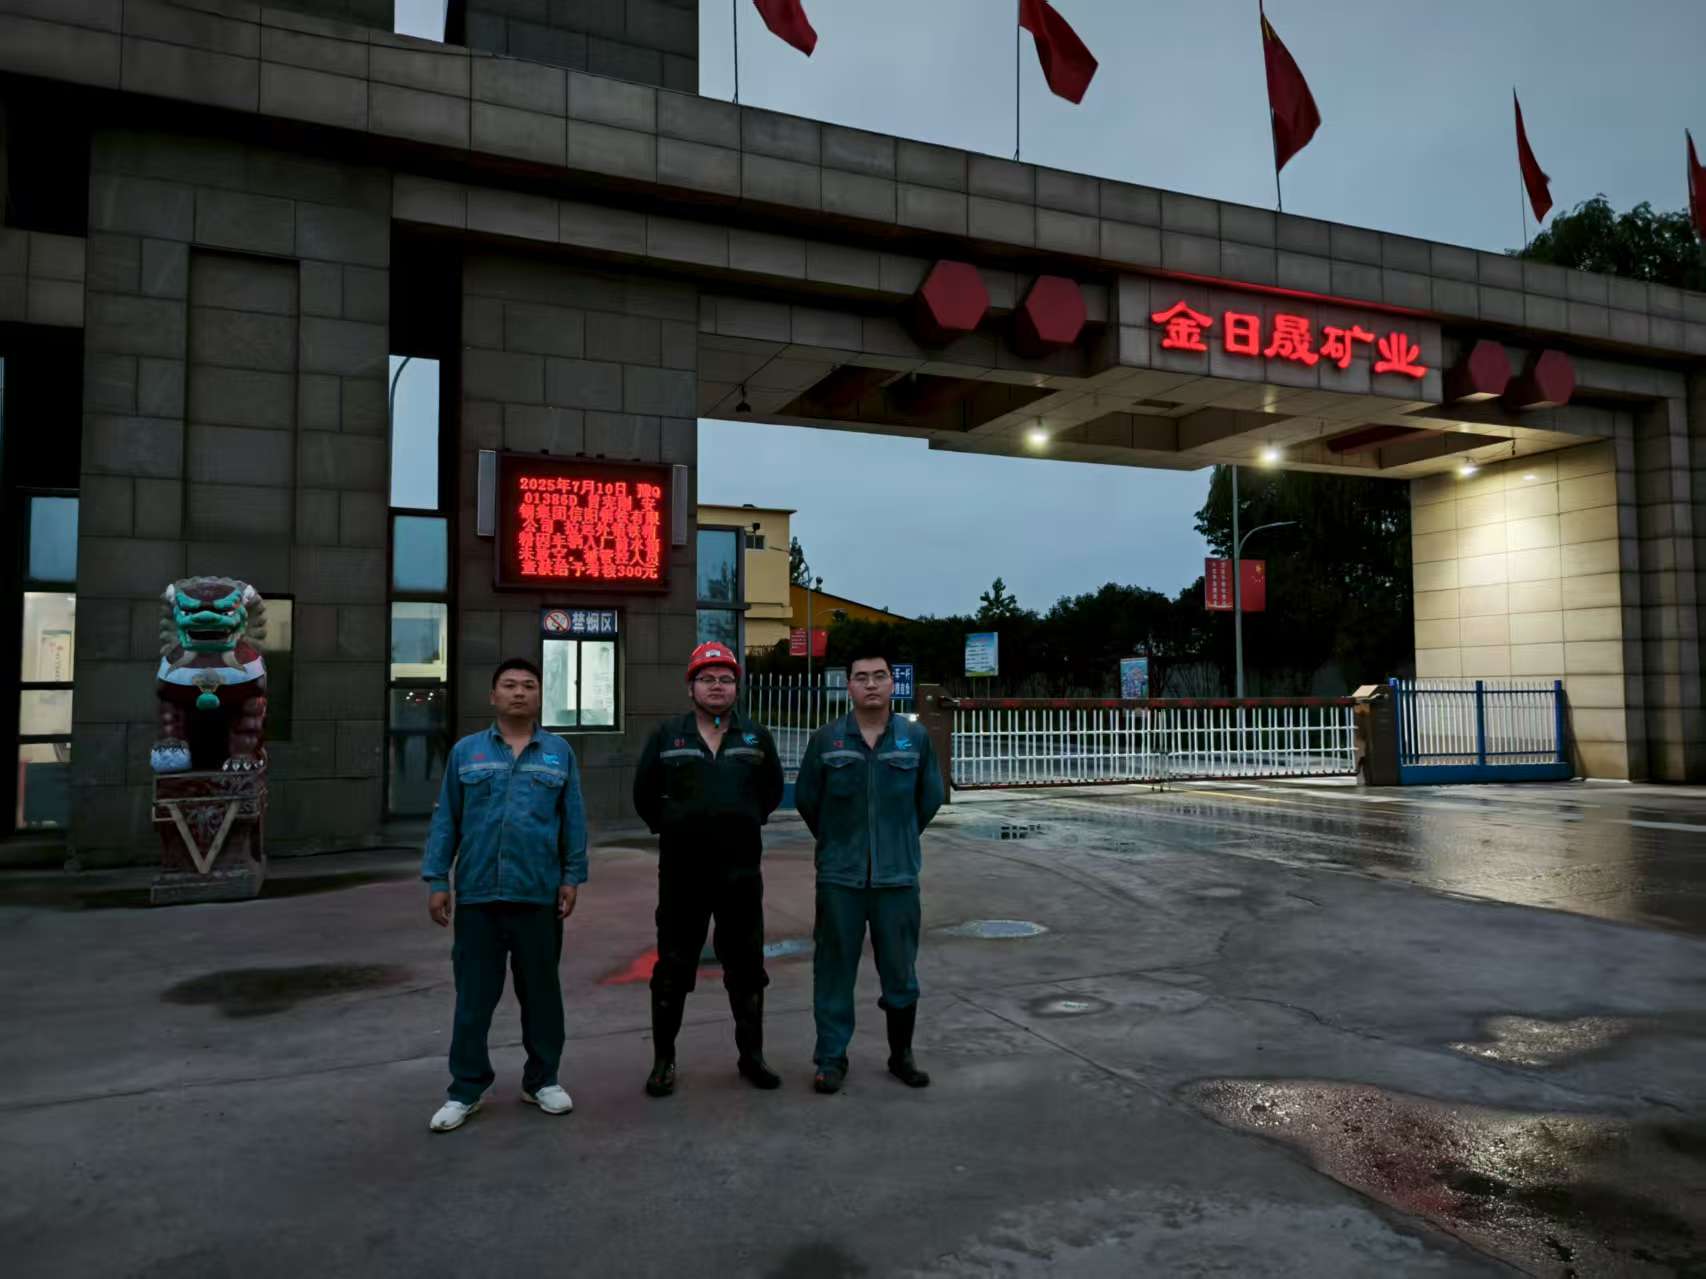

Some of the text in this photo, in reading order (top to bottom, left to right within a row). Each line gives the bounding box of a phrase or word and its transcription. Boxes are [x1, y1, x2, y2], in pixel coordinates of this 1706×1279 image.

[1151, 300, 1428, 379] 金日晟矿业
[519, 476, 626, 496] 2025年7月10日
